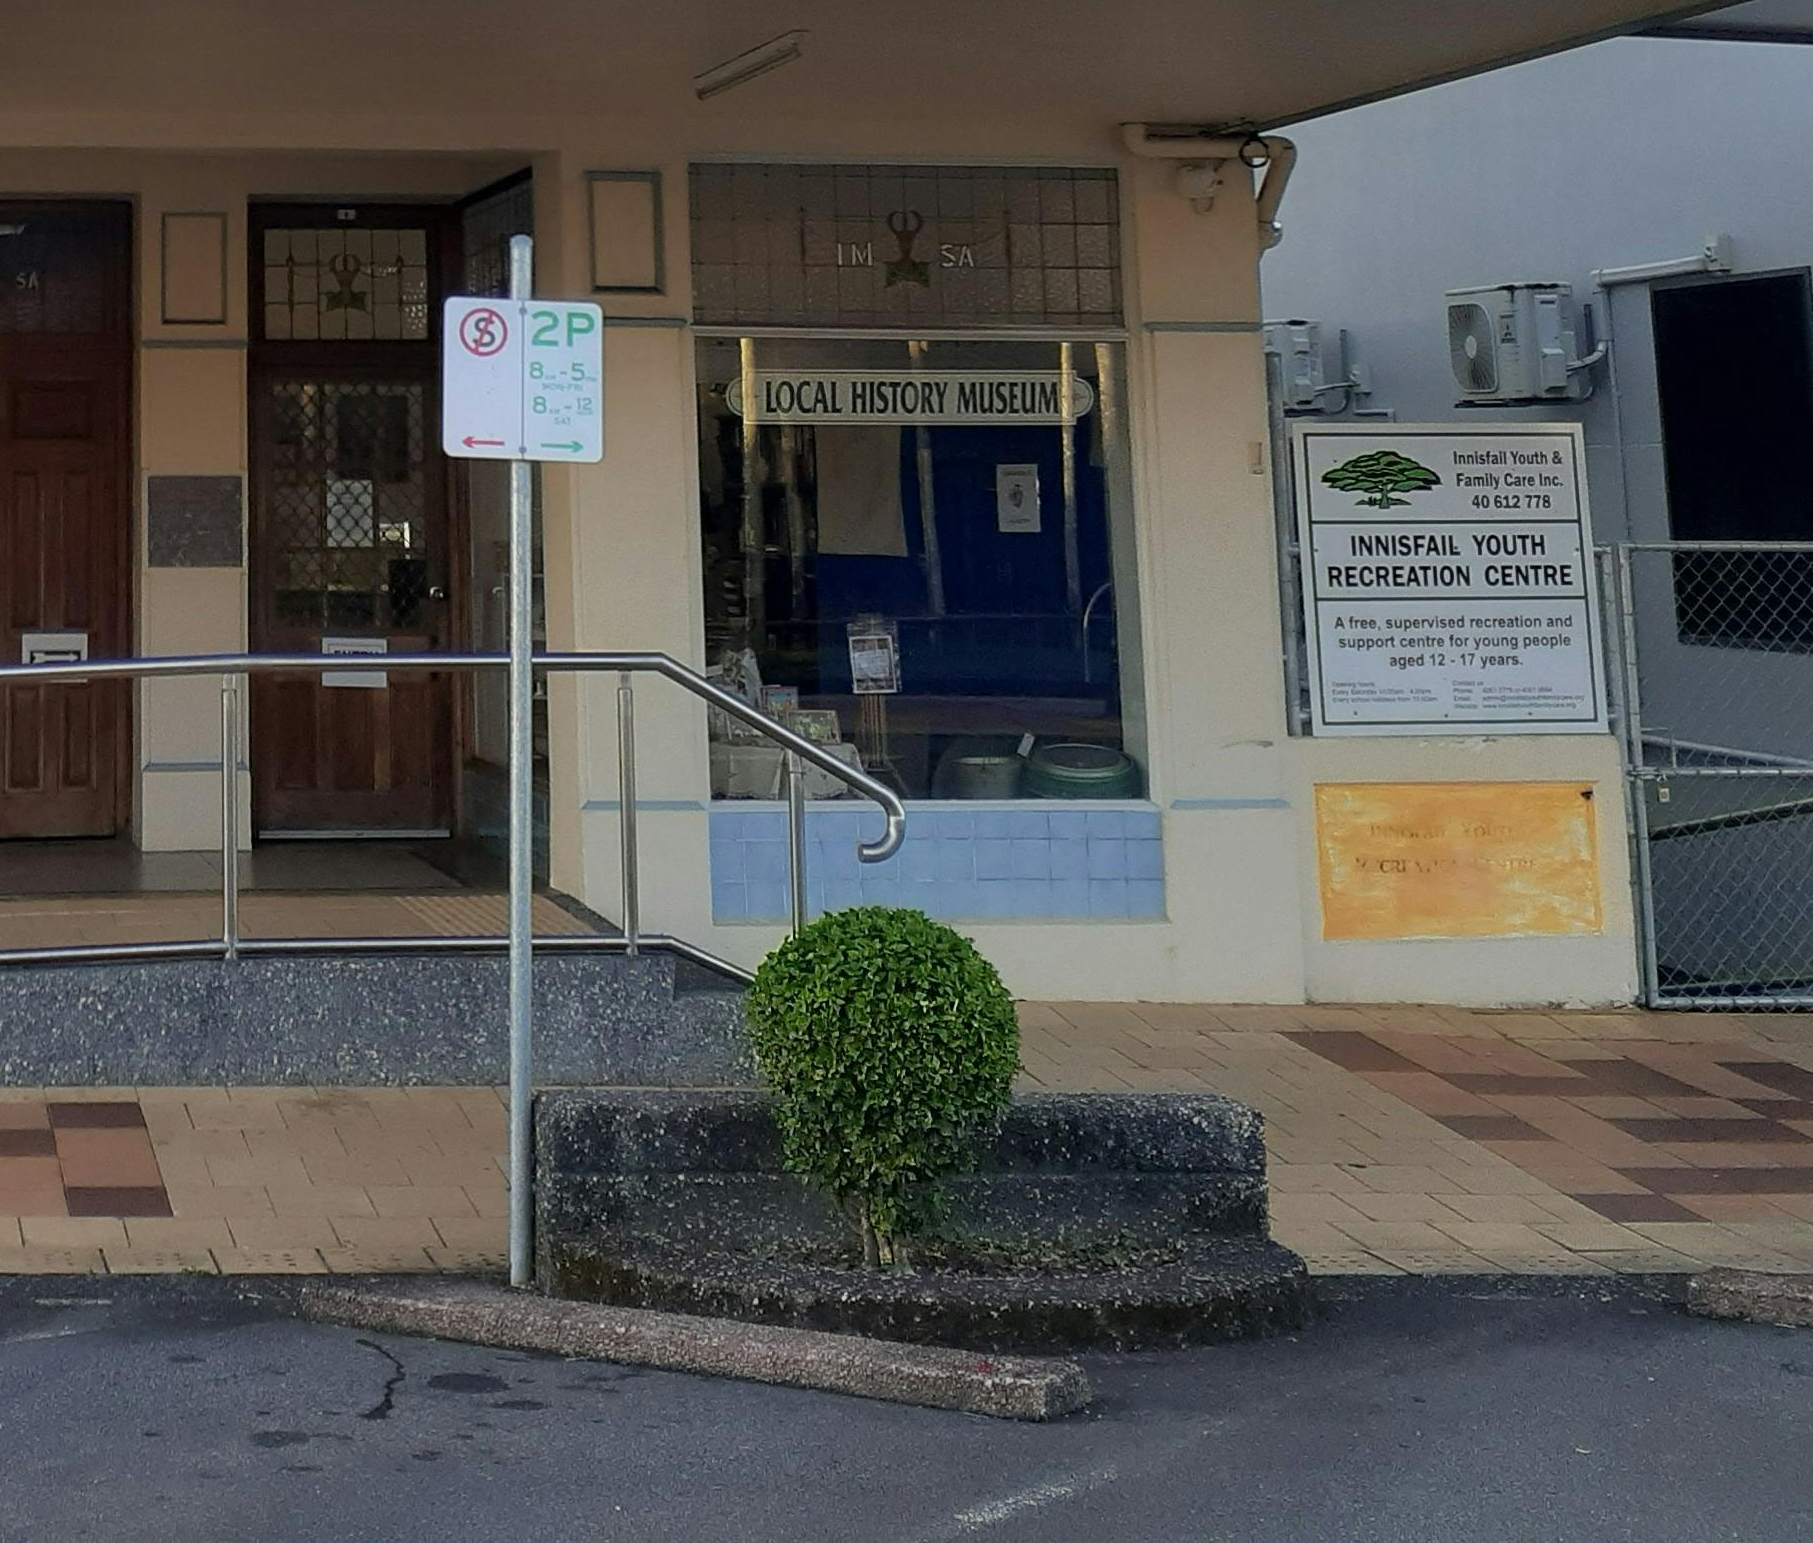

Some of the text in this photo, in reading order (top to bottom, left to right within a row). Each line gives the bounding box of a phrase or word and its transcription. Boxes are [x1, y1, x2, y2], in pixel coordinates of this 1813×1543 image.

[531, 310, 595, 347] 2P
[765, 380, 1059, 415] LOCAL HISTORY MUSEUM
[1453, 451, 1563, 465] Innisfail Youth &
[1456, 473, 1564, 489] Family Care Inc.
[1472, 495, 1551, 509] 40 612 778
[1350, 534, 1546, 557] INNISFAIL YOUTH
[1328, 564, 1574, 588] RECREATION CENTRE
[1334, 615, 1573, 631] A free, supervised recreation and
[1339, 633, 1571, 651] support centre for young people
[1389, 653, 1424, 669] aged
[1430, 654, 1445, 666] 12
[1461, 653, 1475, 666] 17
[1480, 655, 1523, 669] years.
